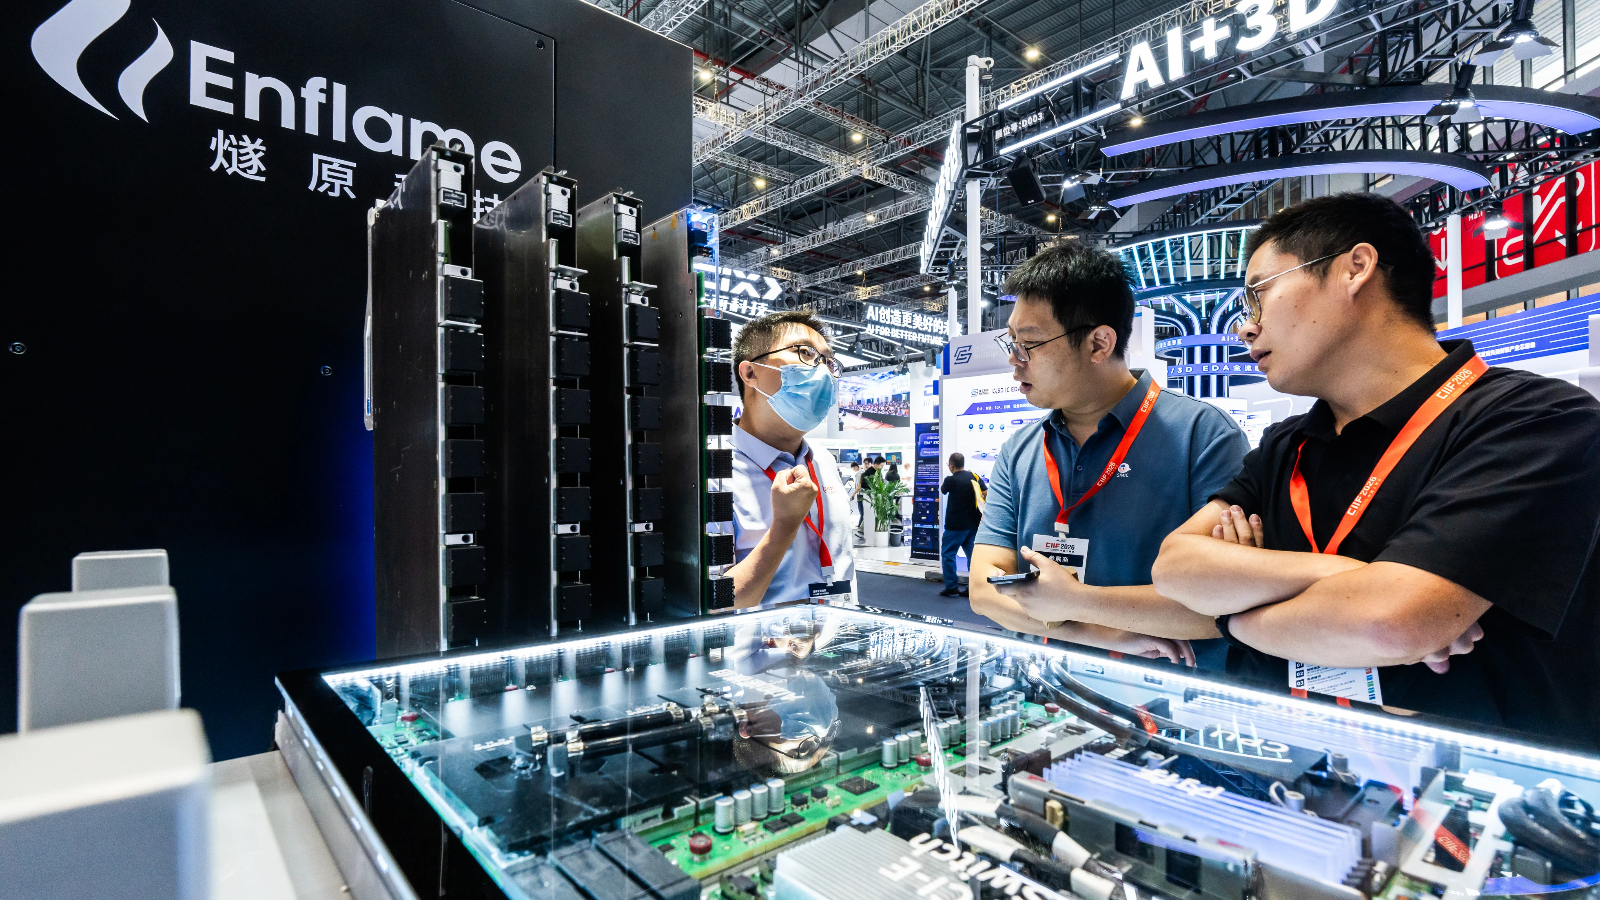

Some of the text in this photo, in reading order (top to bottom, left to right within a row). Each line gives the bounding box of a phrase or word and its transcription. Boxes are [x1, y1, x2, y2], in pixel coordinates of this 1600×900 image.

[1121, 0, 1339, 100] AI+3D
[189, 40, 522, 183] Enflame
[875, 325, 890, 336] FOR
[891, 329, 917, 342] BETTER
[917, 333, 944, 346] FUTURE
[1435, 381, 1455, 400] CIIF
[1451, 368, 1473, 385] 2026
[1141, 400, 1150, 412] CIIF
[1096, 473, 1107, 487] CIIF
[1346, 495, 1362, 516] CIIF
[1360, 476, 1377, 496] 2026
[1045, 541, 1060, 549] CIIF
[1060, 543, 1075, 551] 2026
[1208, 730, 1290, 753] CPU
